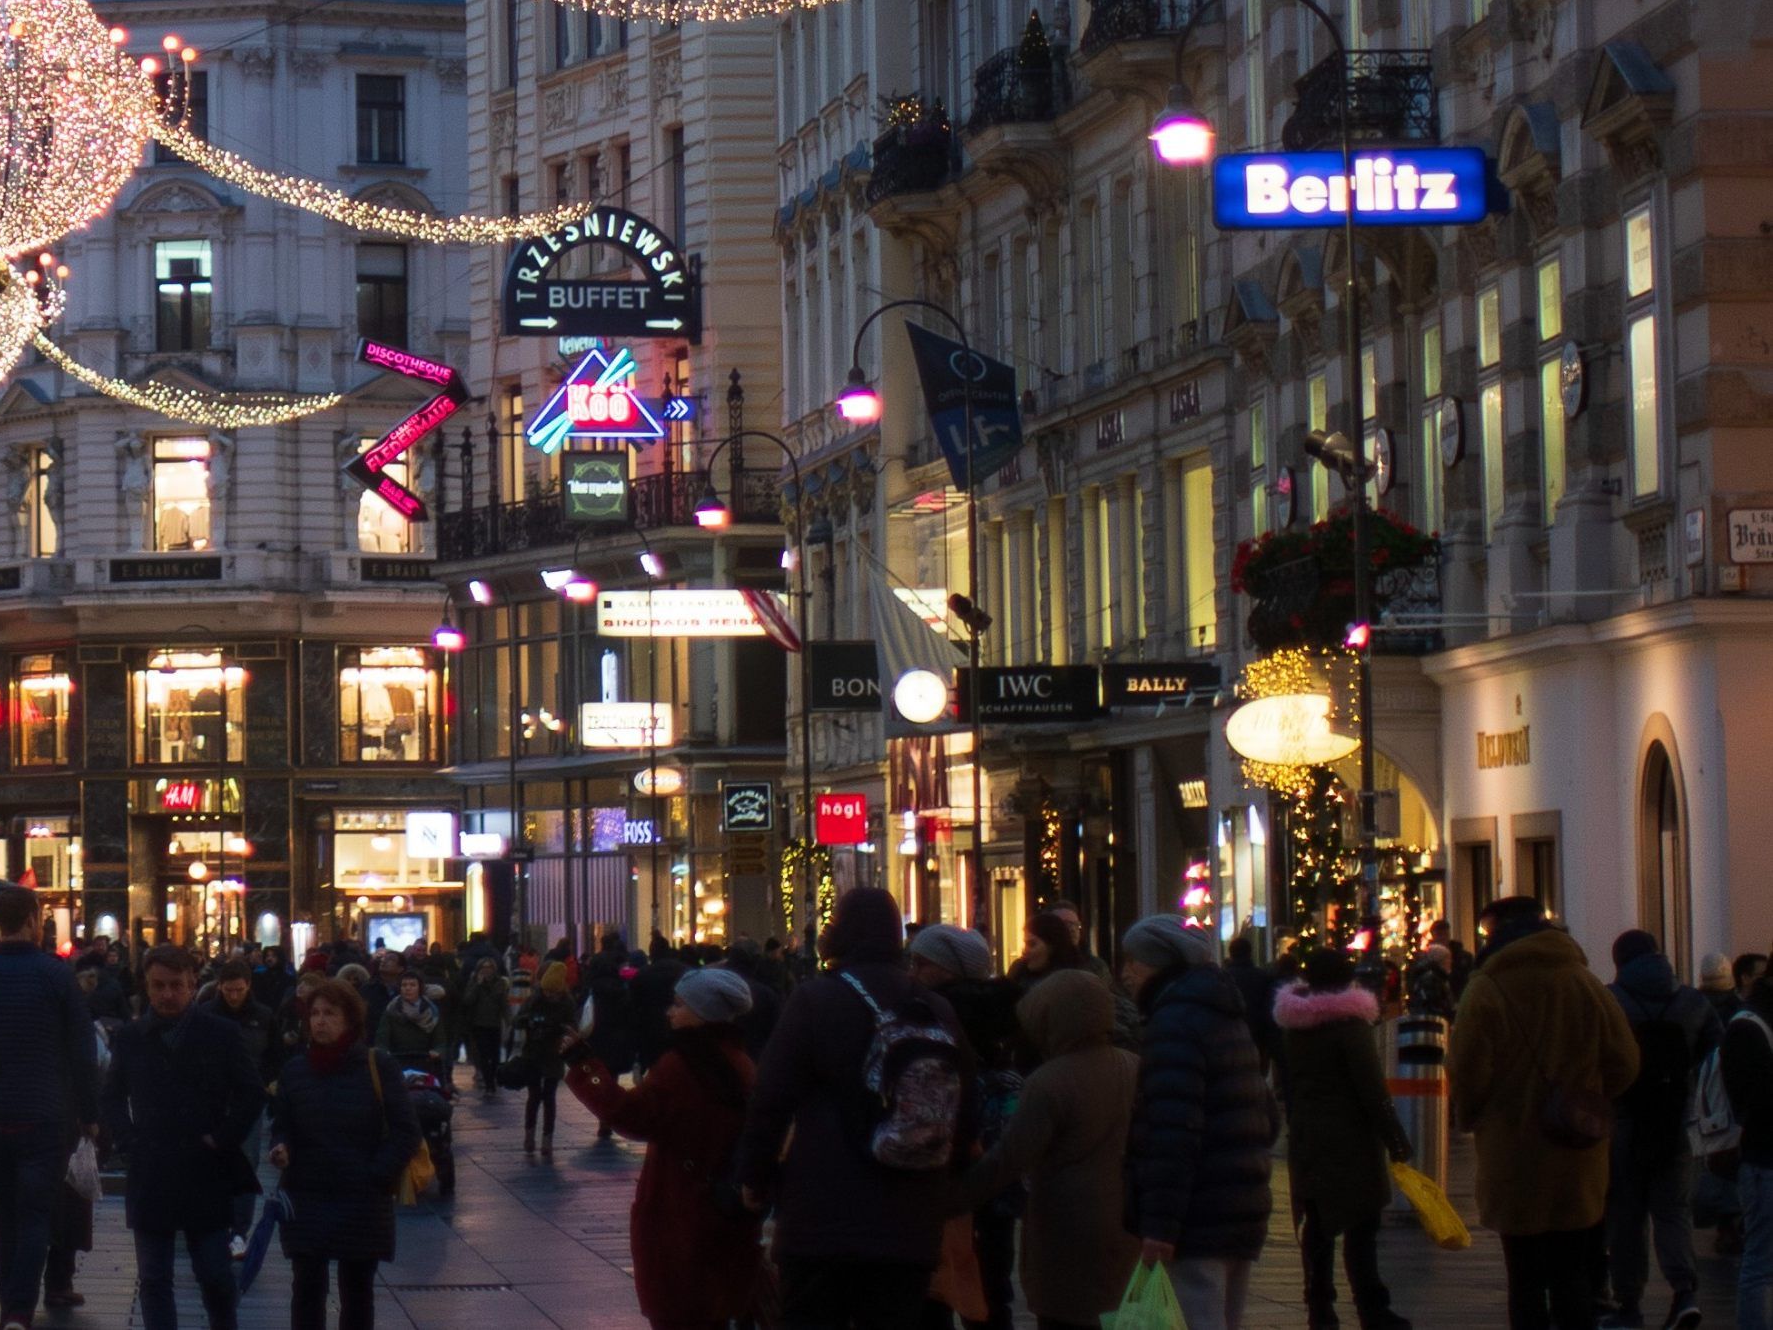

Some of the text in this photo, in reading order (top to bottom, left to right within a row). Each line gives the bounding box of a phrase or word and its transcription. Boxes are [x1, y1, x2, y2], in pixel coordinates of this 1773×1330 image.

[1245, 155, 1457, 213] Berlitz
[548, 286, 650, 309] BUFFET
[366, 343, 452, 380] DISCOTHEQUE
[366, 397, 456, 473] FLEDERMAUS
[998, 675, 1052, 698] IWC
[1127, 677, 1188, 692] BALLY
[979, 703, 1073, 713] SCHAFFHAUSEN
[164, 783, 200, 807] H&M
[821, 801, 862, 819] högl
